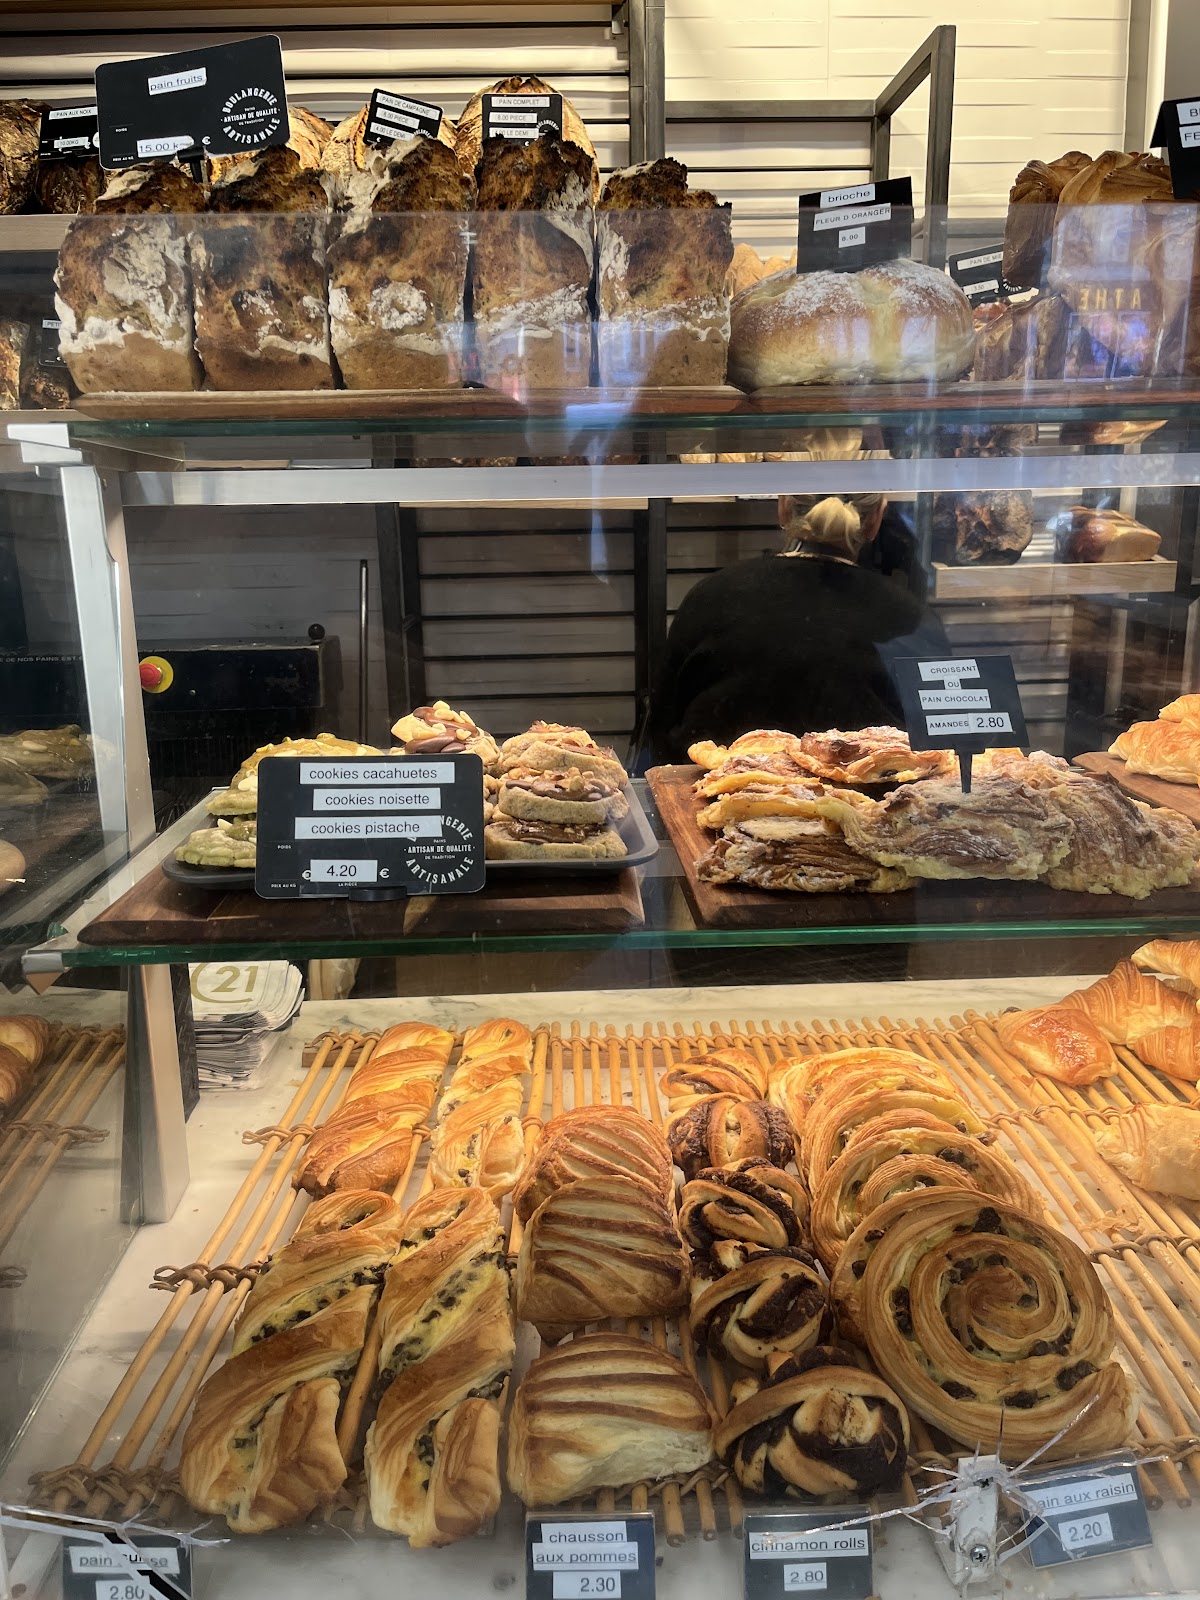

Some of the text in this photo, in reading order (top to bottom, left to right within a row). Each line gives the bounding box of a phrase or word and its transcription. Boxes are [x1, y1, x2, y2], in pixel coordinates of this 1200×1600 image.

[150, 74, 203, 91] pain fruits
[222, 88, 278, 113] BOULANGERIE
[381, 96, 394, 104] PAIN
[401, 102, 431, 115] CAMPAGNE
[223, 113, 247, 123] ARTISAN
[222, 117, 281, 144] ARTISANALE
[139, 143, 170, 153] 15.00
[828, 190, 871, 203] brioche
[815, 216, 841, 225] FLEUR
[851, 208, 890, 220] ORANGER
[930, 665, 977, 674] CROISSANT
[944, 695, 988, 703] CHOCOLAT
[929, 716, 1005, 729] AMANDES 2.80
[309, 767, 438, 780] cookies cacahuetes
[325, 792, 430, 806] cookies noisette
[311, 821, 420, 835] cookies pistache
[408, 845, 435, 853] ARTISAN
[436, 845, 445, 853] DE
[326, 864, 357, 877] 4.20
[405, 856, 474, 884] ARTISANALE
[210, 965, 259, 993] 21
[1064, 1491, 1092, 1505] aux
[1096, 1482, 1135, 1498] raisin
[549, 1532, 624, 1543] chausson
[1068, 1521, 1103, 1543] 2.20
[751, 1538, 866, 1552] cinnamon rolls
[80, 1554, 113, 1567] pain
[536, 1552, 637, 1564] aux pommes
[790, 1570, 824, 1584] 2.80
[580, 1577, 616, 1593] 2.30
